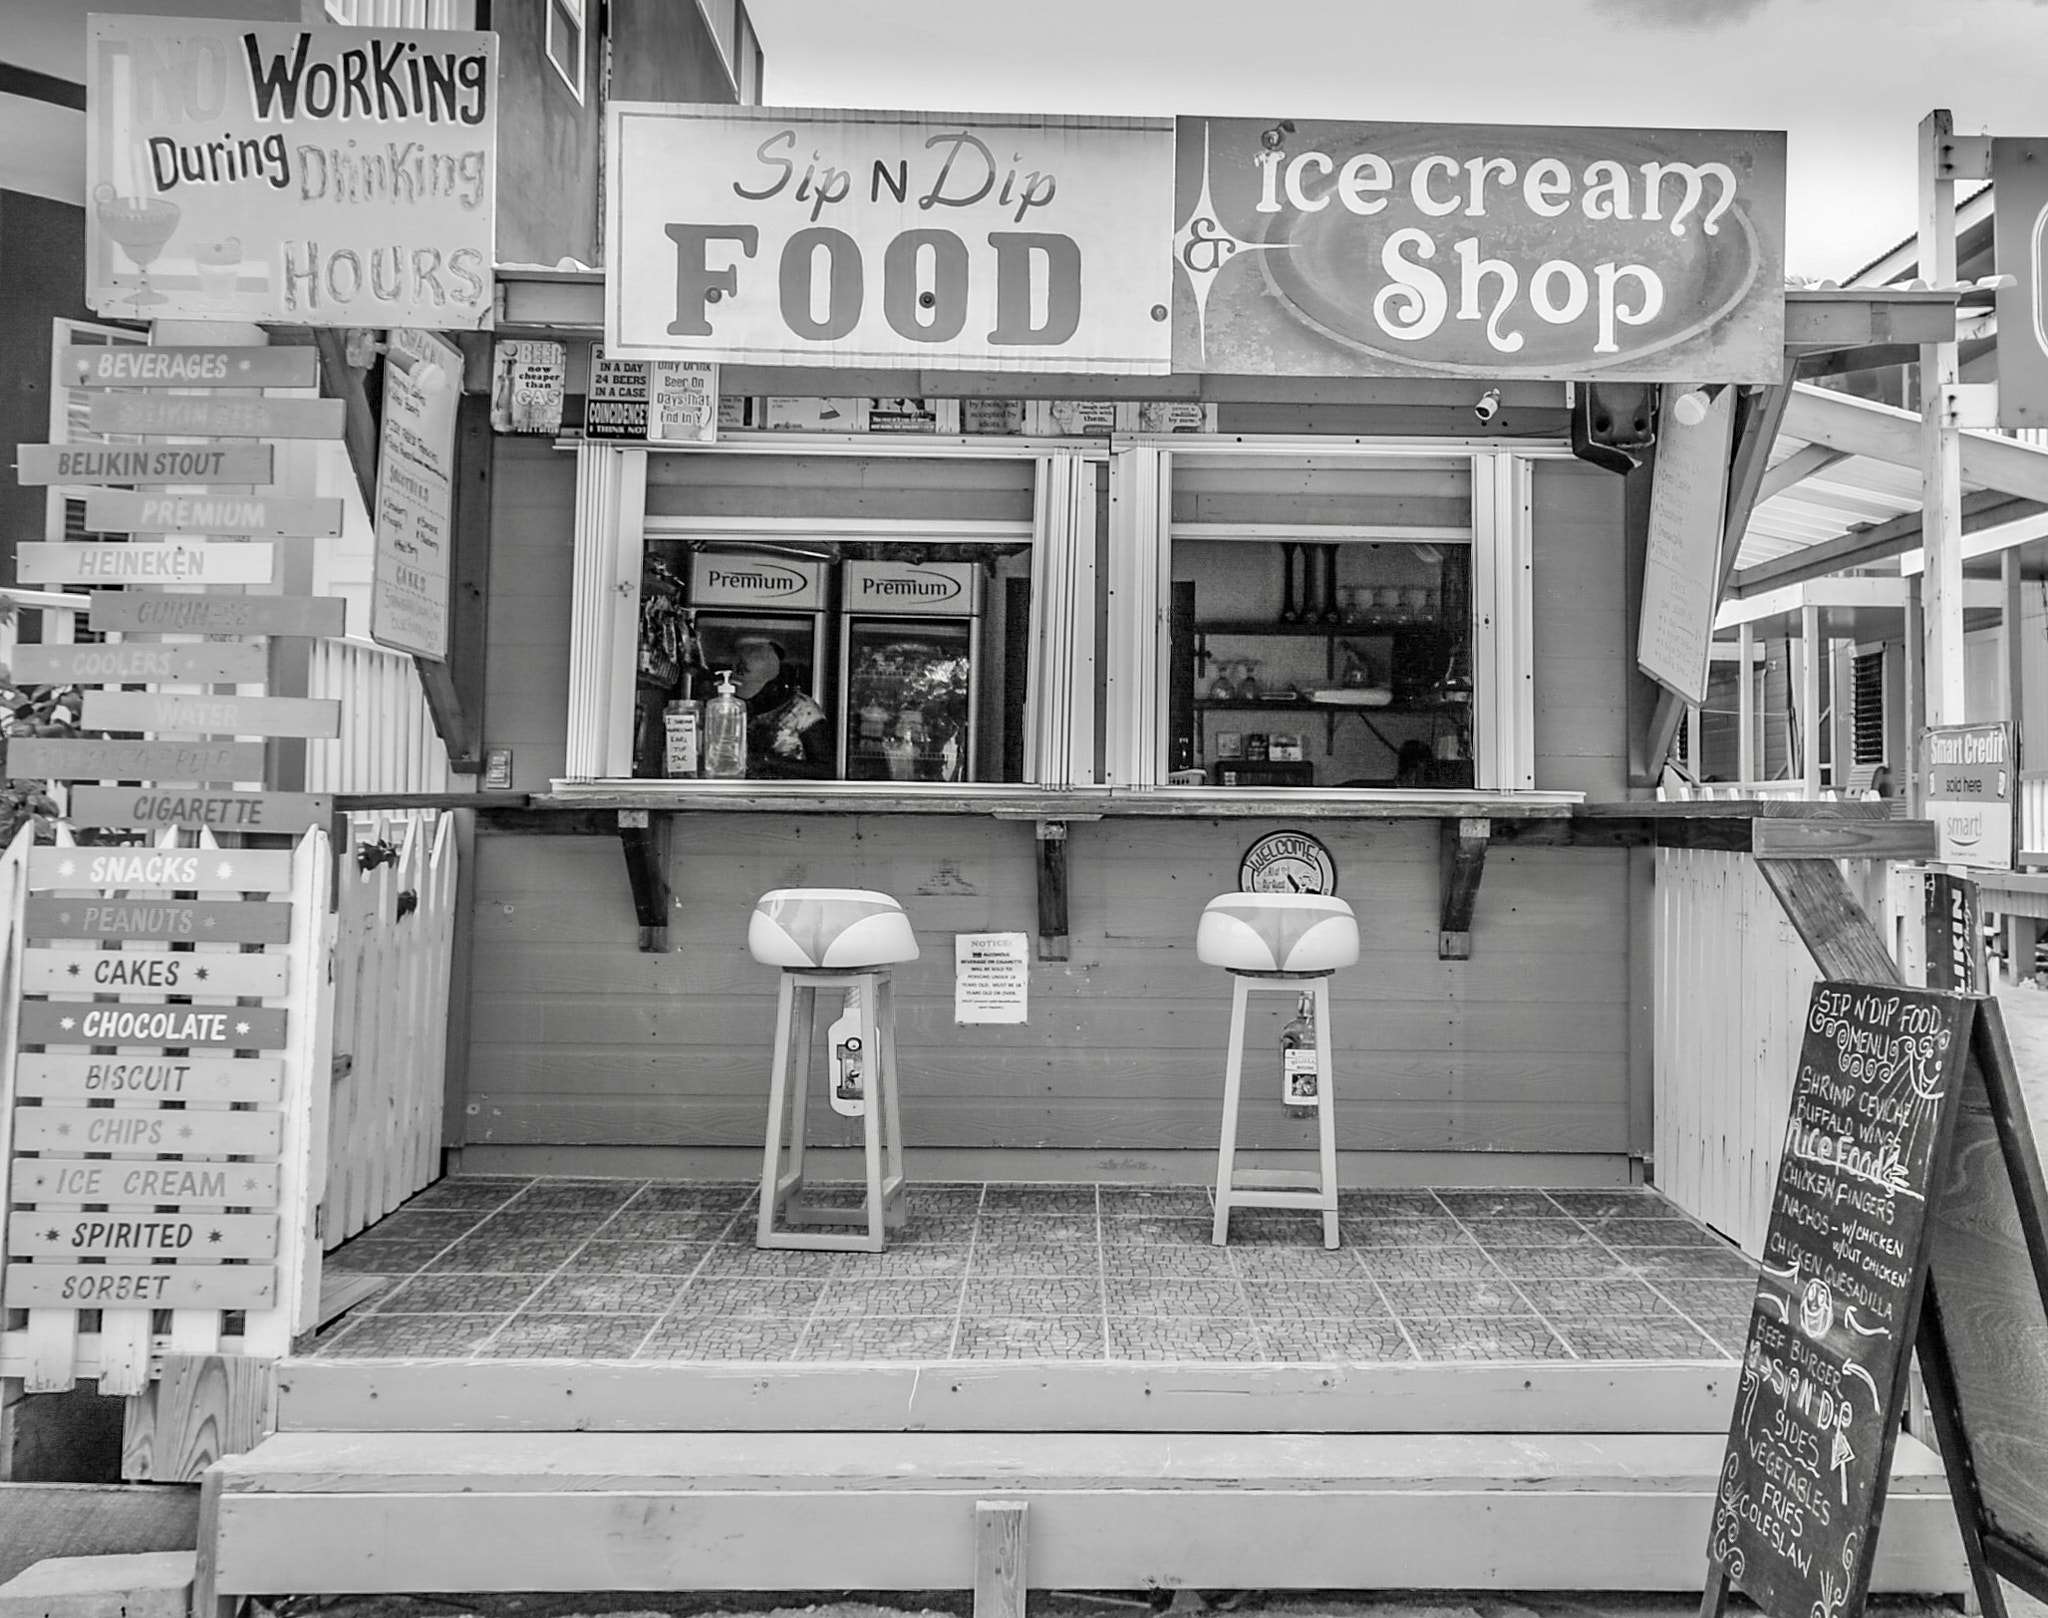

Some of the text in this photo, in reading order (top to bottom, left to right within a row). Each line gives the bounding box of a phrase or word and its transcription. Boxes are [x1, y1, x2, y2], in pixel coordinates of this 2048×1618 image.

[149, 132, 291, 192] During
[732, 129, 1057, 223] Sip N Dip
[283, 240, 484, 310] HOURS
[664, 223, 1082, 345] FOOD
[1373, 227, 1666, 354] Shop
[97, 353, 229, 379] BEVERAGES
[518, 342, 563, 365] BEER
[519, 372, 560, 382] cheaper
[595, 374, 647, 386] 24 BEERS
[600, 362, 643, 373] IN A DAY
[526, 381, 552, 389] than
[595, 387, 646, 398] IN A CASE
[665, 375, 705, 388] Beer On
[515, 388, 562, 407] GAS
[657, 392, 710, 407] Days That
[597, 425, 625, 434] THINK
[682, 412, 692, 424] In
[695, 412, 703, 424] Y
[57, 452, 225, 476] BELIKIN STOUT
[140, 501, 266, 528] PREMIUM
[77, 550, 204, 576] HEINEKEN
[708, 570, 793, 591] Premium
[862, 577, 948, 596] Premium
[72, 652, 172, 676] COOLERS
[154, 703, 239, 727] WATER
[1930, 732, 2004, 765] Smart Credit
[1945, 777, 1982, 793] sold here
[133, 796, 263, 824] CIGARETTE
[1946, 811, 1982, 837] smart!
[90, 856, 199, 883] SNACKS
[1248, 838, 1319, 874] WELCOME
[83, 906, 193, 934] PEANUTS
[94, 959, 180, 987] CAKES
[82, 1010, 228, 1041] CHOCOLATE
[1819, 989, 1852, 1018] SIP
[1900, 1004, 1942, 1035] FOOD
[1848, 1026, 1890, 1061] MENU
[85, 1064, 191, 1092] BISCUIT
[1800, 1065, 1910, 1128] SHRIMP CEVICHE
[1796, 1095, 1854, 1136] BUFFALO
[88, 1118, 163, 1144] CHIPS
[56, 1168, 226, 1197] ICE CREAM
[1782, 1160, 1896, 1226] CHICKEN FINGERS
[1781, 1194, 1830, 1236] NACHOS
[71, 1222, 193, 1248] SPIRITED
[62, 1275, 170, 1300] SORBET
[1770, 1232, 1893, 1321] CHICKEN QUESADILLA
[1755, 1315, 1786, 1350] BEEF
[1790, 1339, 1844, 1398] BURGER
[1774, 1409, 1820, 1467] SIDES
[1749, 1436, 1831, 1526] VEGETABLES
[1761, 1482, 1804, 1537] FRIES
[1740, 1494, 1813, 1578] COLESLAW
